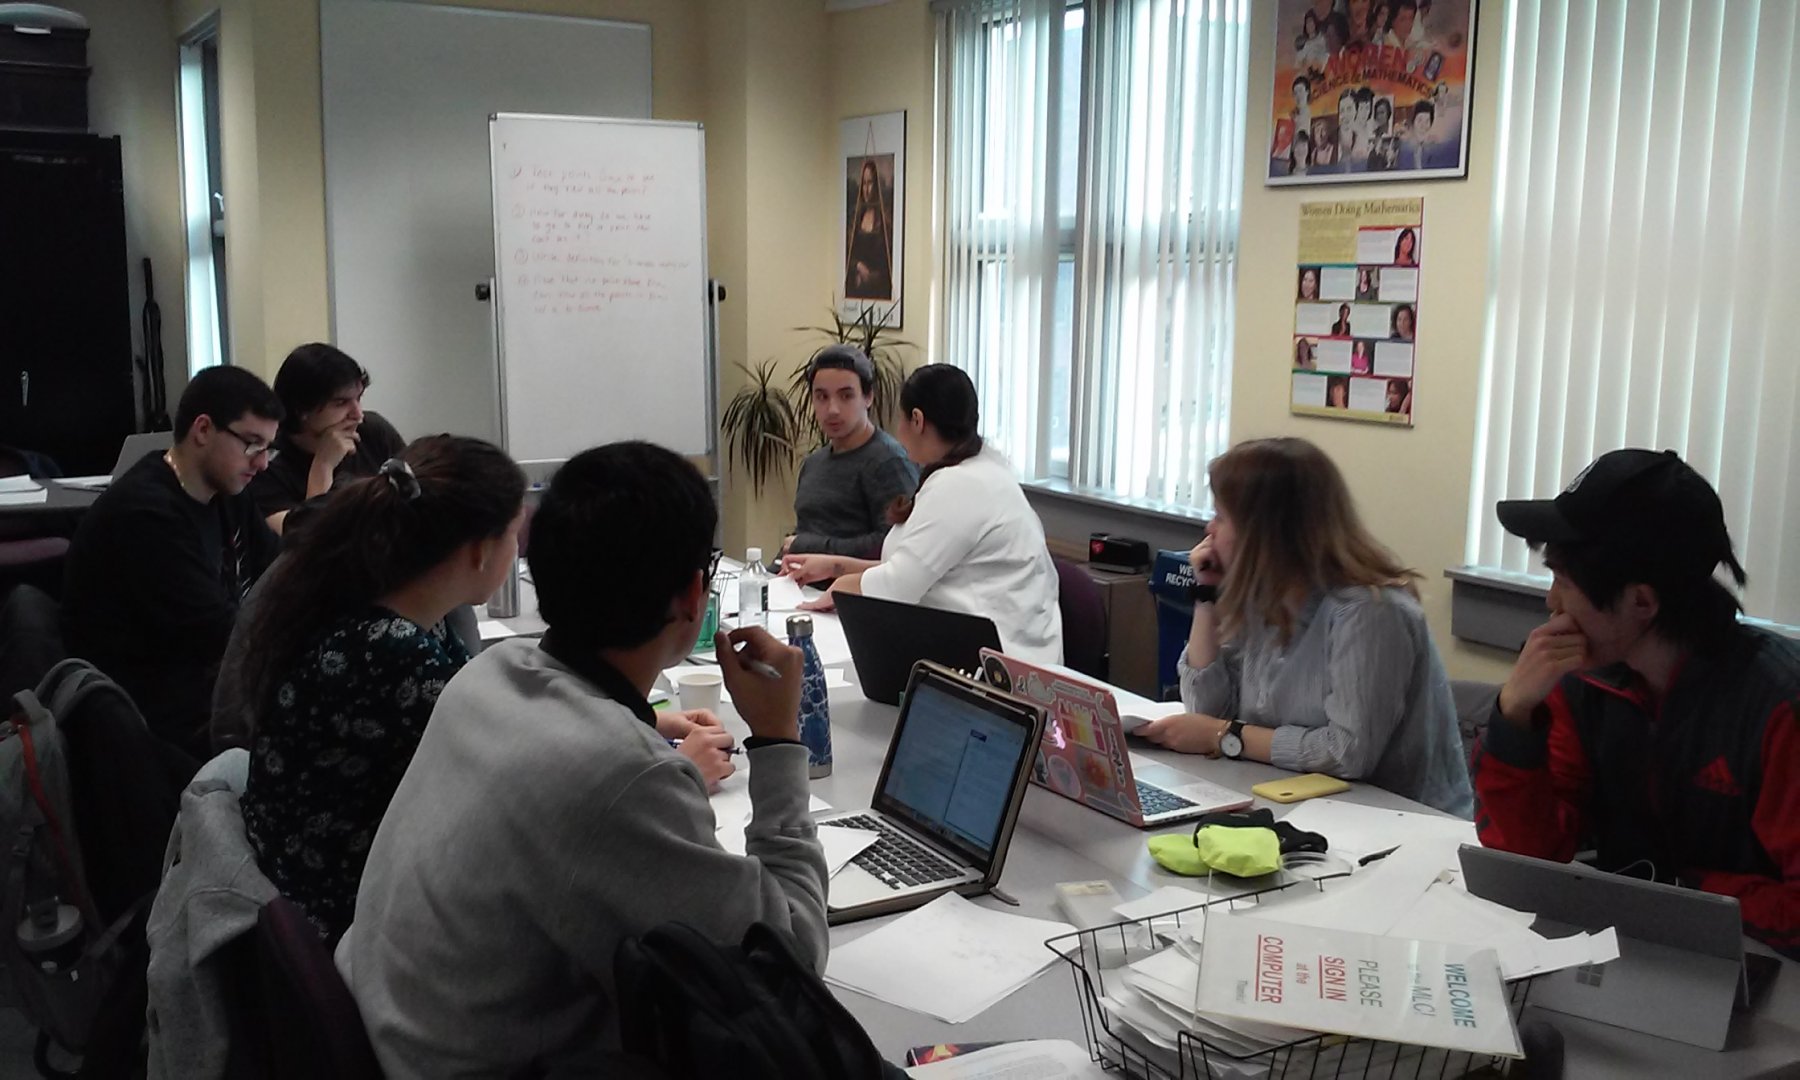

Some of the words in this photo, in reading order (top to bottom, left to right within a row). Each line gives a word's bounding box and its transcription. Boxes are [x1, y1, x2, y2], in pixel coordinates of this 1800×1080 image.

[1326, 43, 1409, 78] WOMEN
[1361, 68, 1432, 98] MATHEMATICS
[1302, 204, 1332, 216] Women
[1333, 201, 1361, 218] Doing
[1363, 199, 1420, 214] Mathematics
[1179, 563, 1193, 577] WE
[1260, 936, 1283, 1004] COMPUTER
[1296, 962, 1309, 971] at
[1296, 972, 1310, 984] the
[1324, 956, 1346, 986] SIGN
[1325, 988, 1347, 1002] IN
[1358, 959, 1383, 1008] PLEASE
[1444, 963, 1477, 1028] WELCOME
